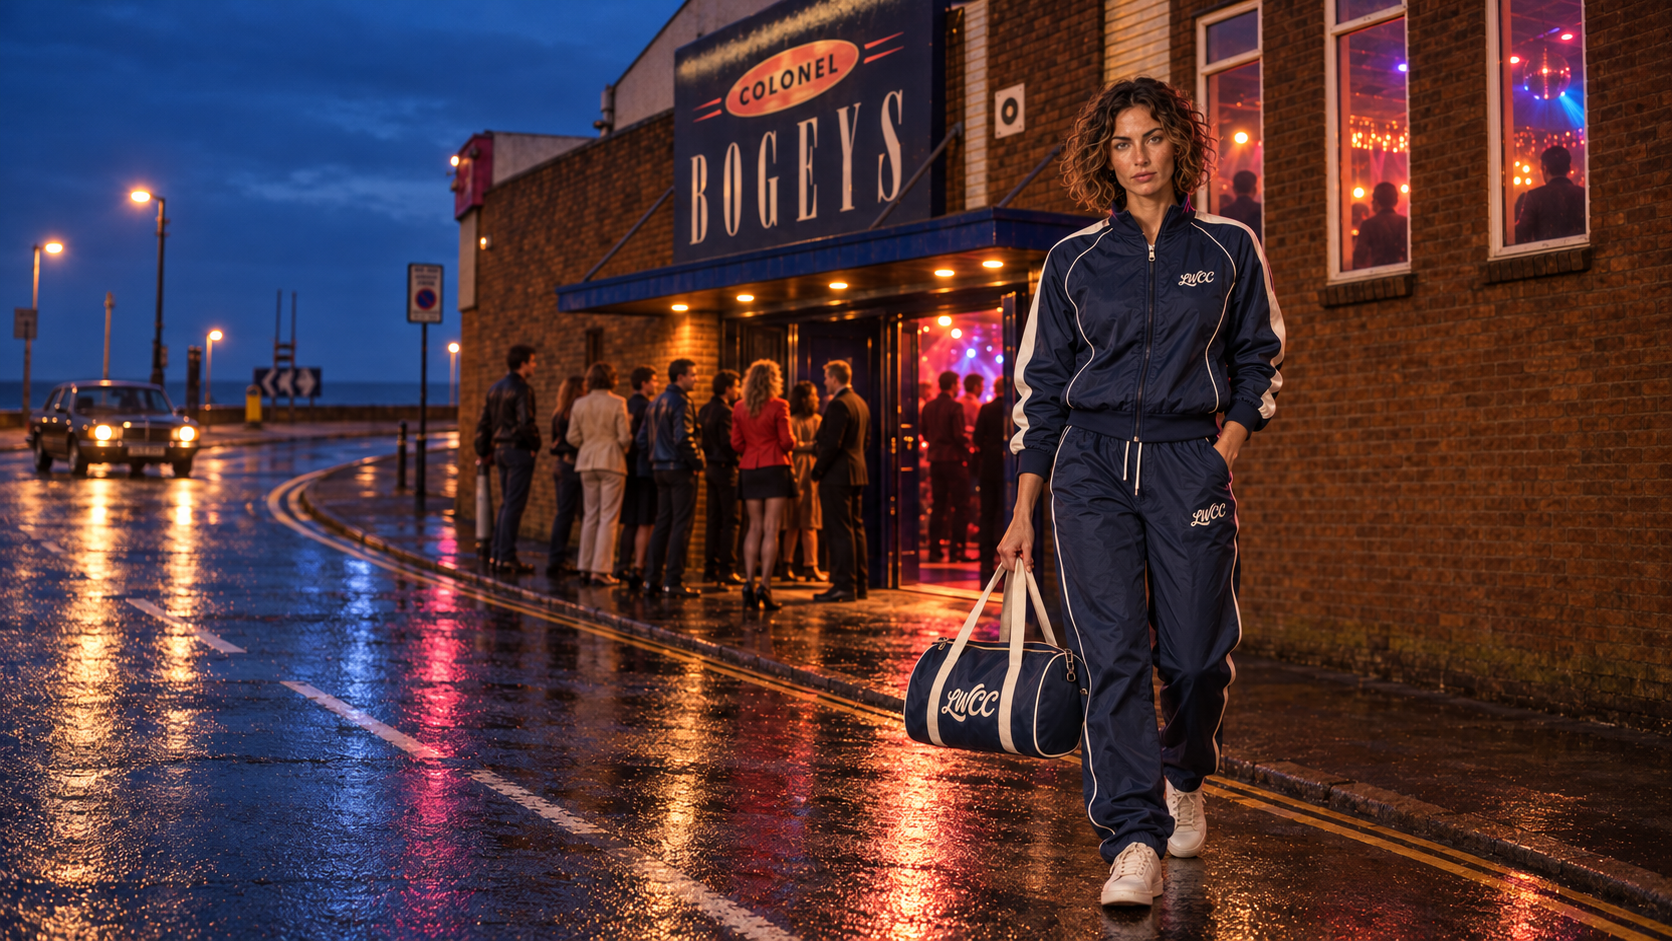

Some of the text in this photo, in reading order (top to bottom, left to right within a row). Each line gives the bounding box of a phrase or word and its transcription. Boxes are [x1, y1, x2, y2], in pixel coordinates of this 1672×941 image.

[739, 54, 838, 106] COLONEL
[690, 89, 903, 245] BOGEYS
[1178, 270, 1215, 287] LWCC
[1190, 502, 1226, 527] LWCC
[941, 683, 999, 722] LWCC
